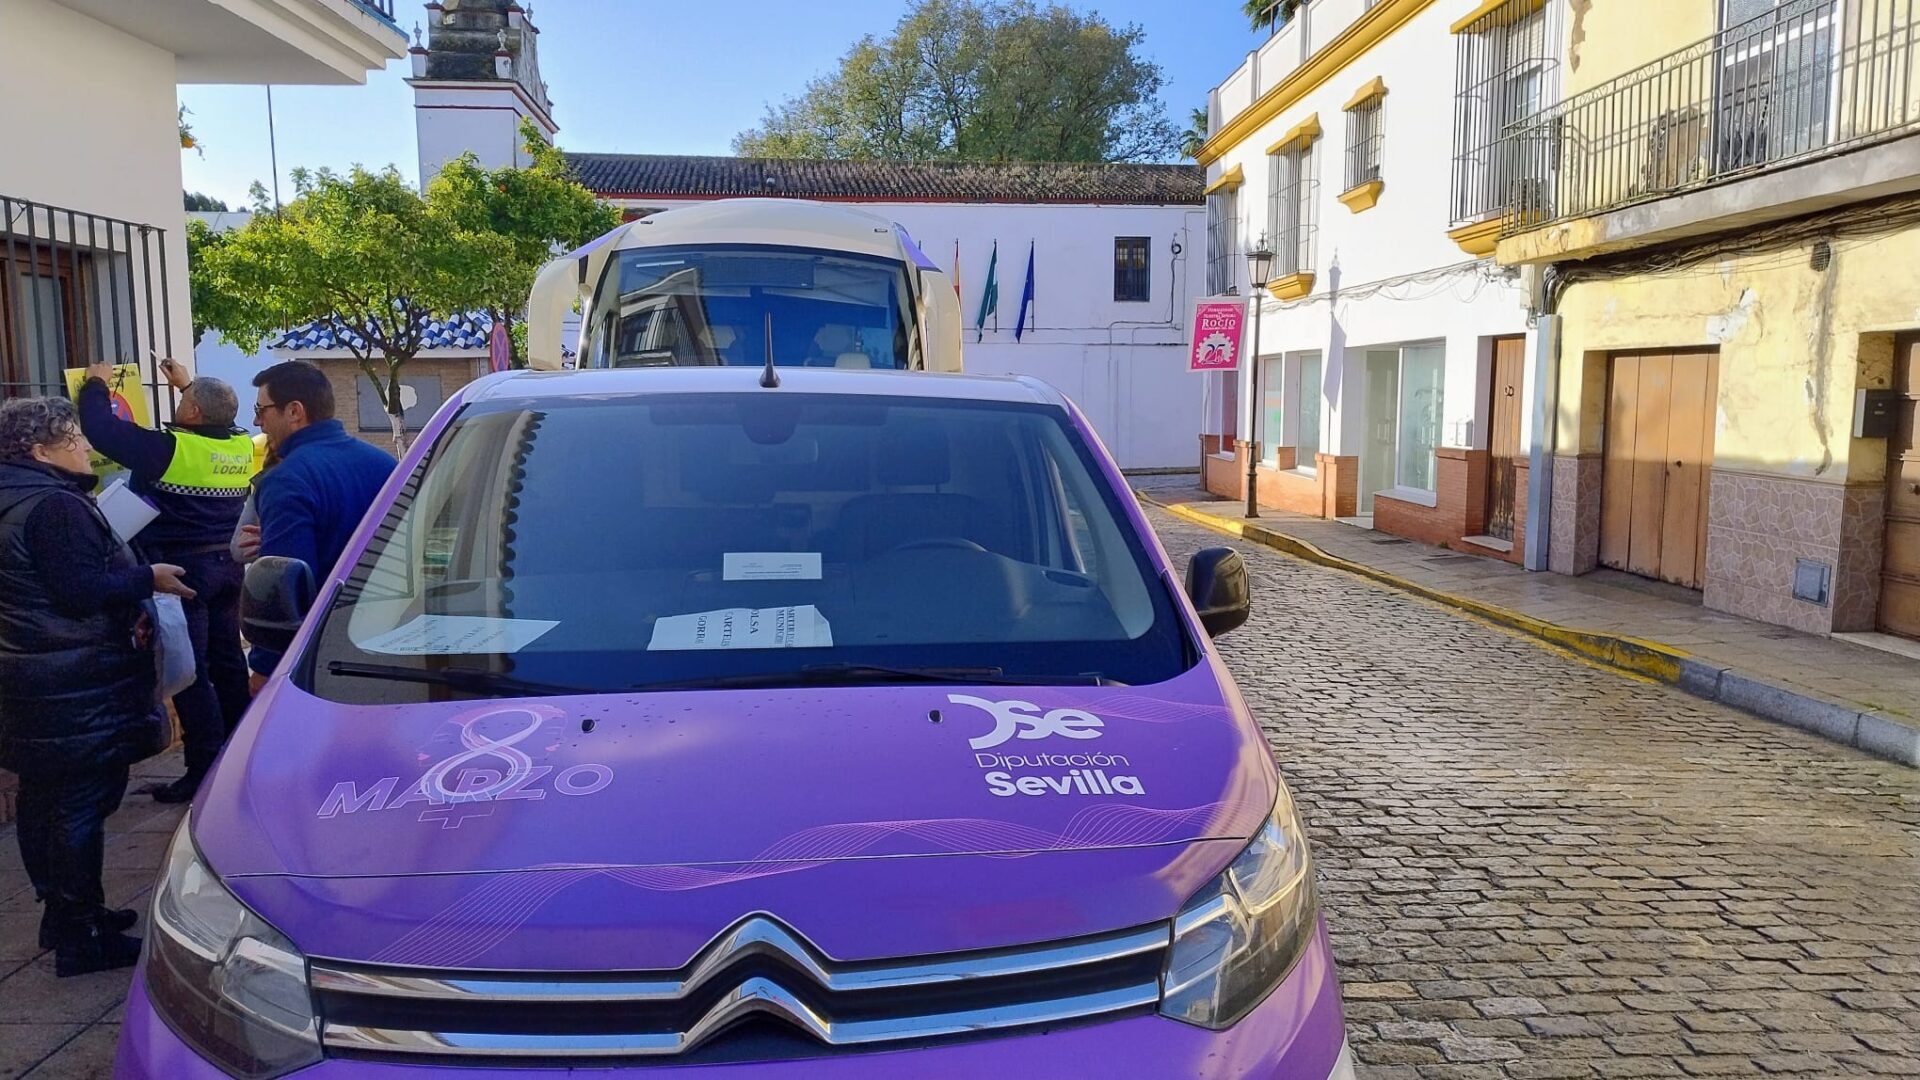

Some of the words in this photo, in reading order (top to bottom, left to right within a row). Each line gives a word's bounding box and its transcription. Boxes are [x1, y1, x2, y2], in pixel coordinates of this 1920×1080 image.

[212, 465, 248, 474] LOCAL
[749, 609, 760, 635] OLSA
[975, 752, 1130, 771] Diputación
[317, 763, 614, 819] MARZO
[984, 769, 1146, 797] Sevilla
